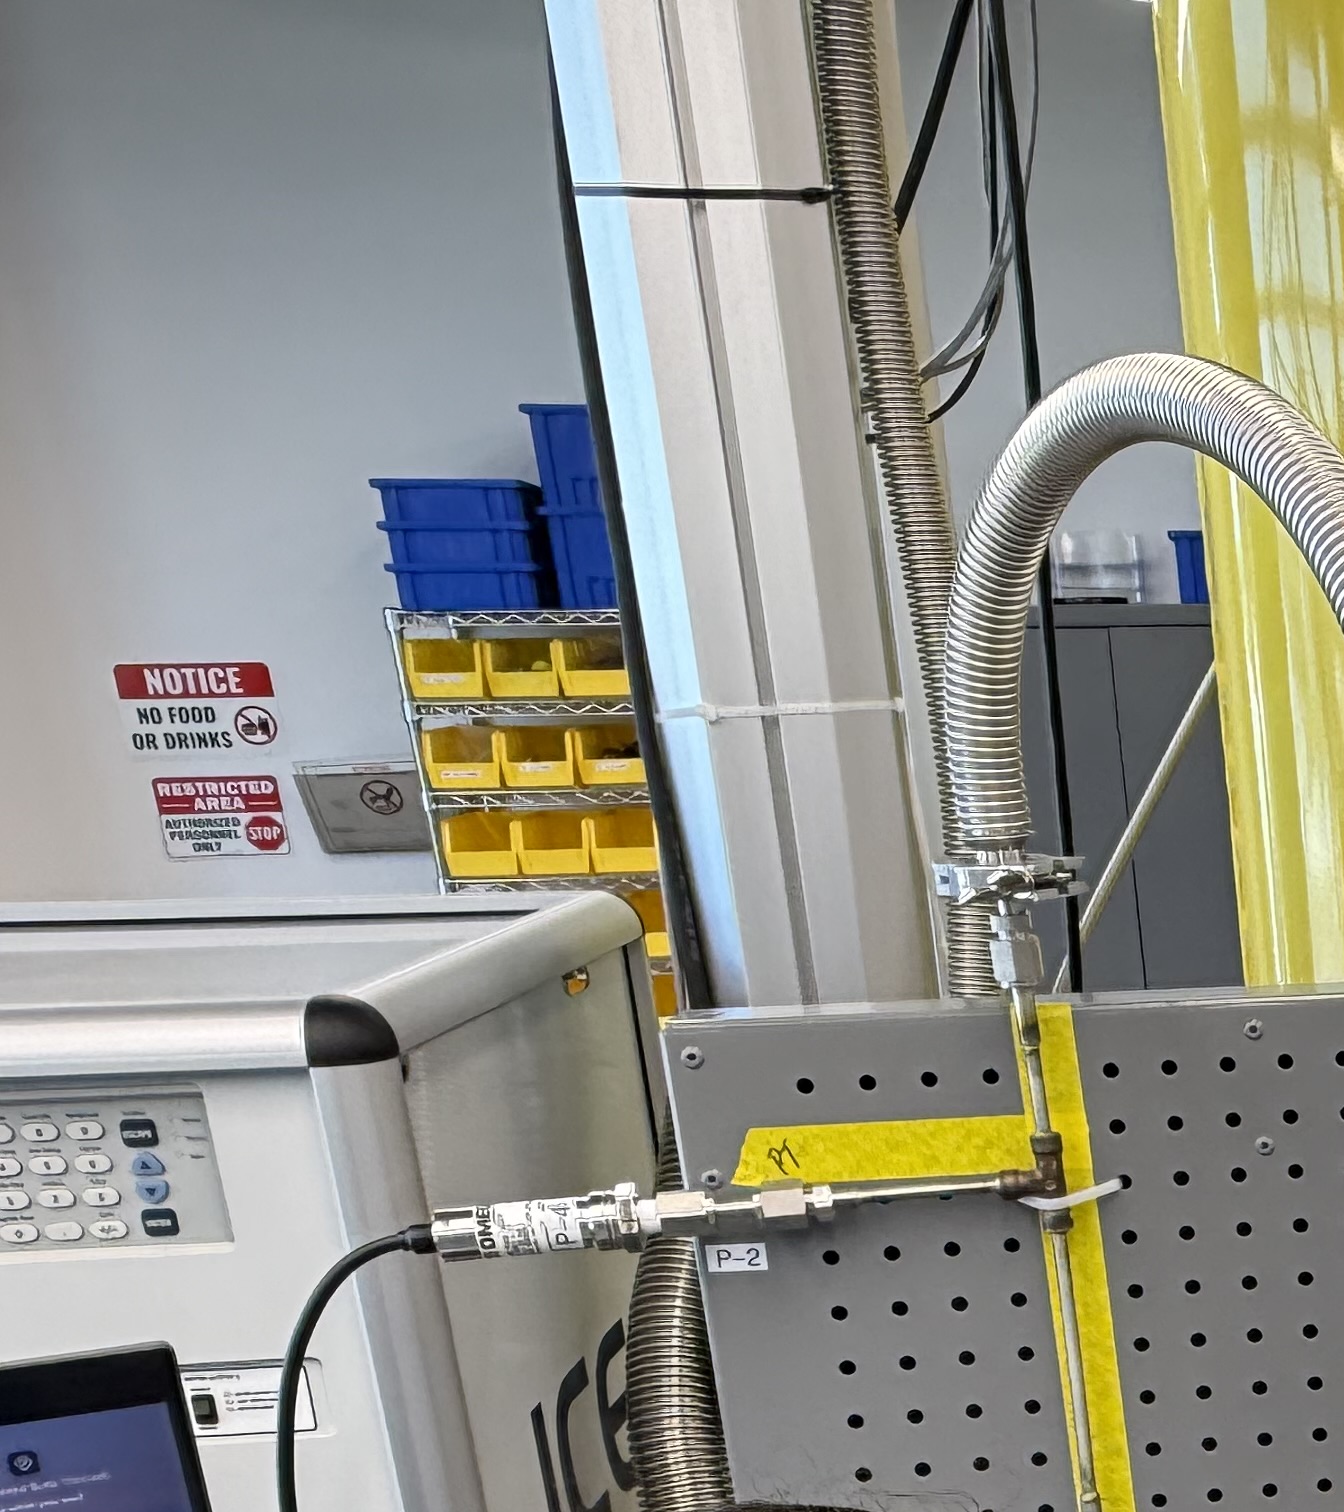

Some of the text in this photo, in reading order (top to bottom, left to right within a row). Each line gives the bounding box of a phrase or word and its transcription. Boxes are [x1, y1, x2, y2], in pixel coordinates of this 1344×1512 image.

[143, 667, 244, 695] NOTICE
[136, 706, 217, 725] NO FOOD
[132, 731, 233, 750] OR DRINKS
[156, 780, 275, 797] RESTRICTED
[194, 797, 246, 811] AREA
[248, 826, 281, 840] STOP
[716, 1248, 761, 1268] P-2
